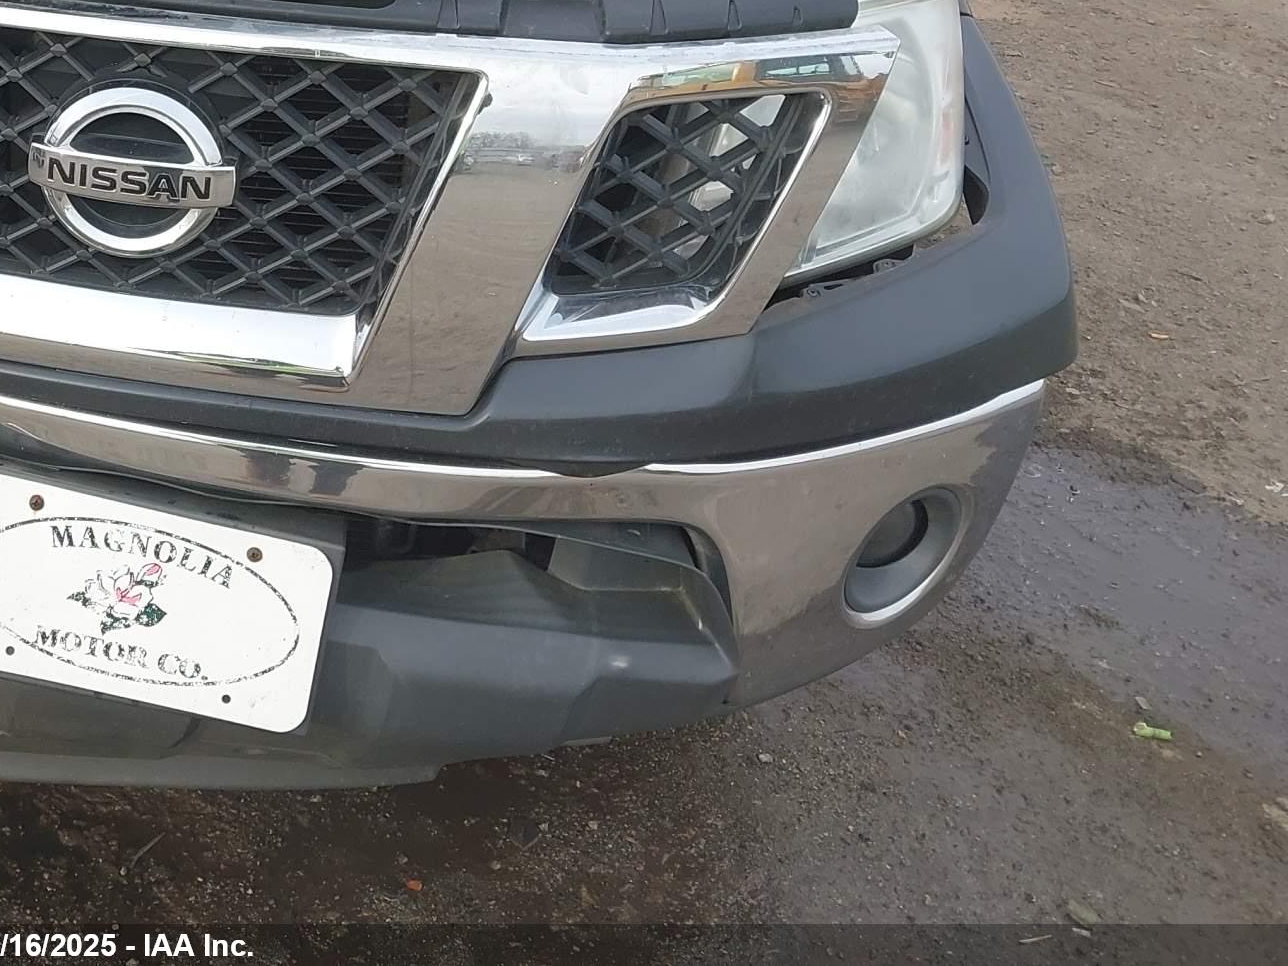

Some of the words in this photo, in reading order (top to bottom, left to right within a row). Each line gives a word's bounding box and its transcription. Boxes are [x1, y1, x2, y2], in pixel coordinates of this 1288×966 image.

[47, 158, 211, 200] NISSAN
[50, 524, 234, 589] MAGNOLIA
[33, 625, 149, 669] MOTOR
[158, 653, 209, 681] CO.
